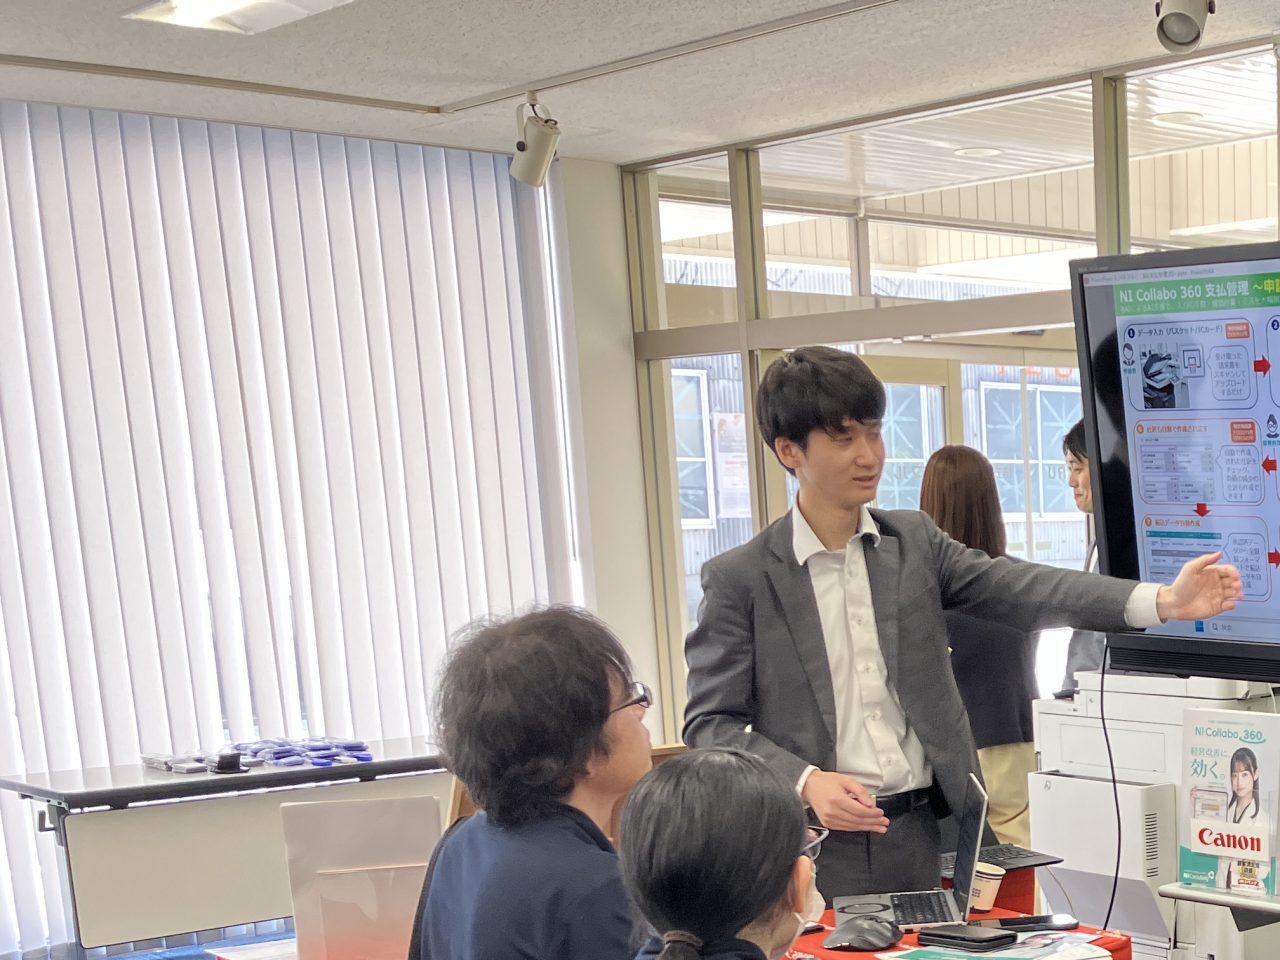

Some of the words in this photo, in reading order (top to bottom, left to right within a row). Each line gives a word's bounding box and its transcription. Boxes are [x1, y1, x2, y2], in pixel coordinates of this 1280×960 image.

[1119, 290, 1133, 303] NI
[1136, 287, 1177, 302] Collabo
[1180, 286, 1202, 299] 360
[1205, 279, 1249, 297] 支払管理
[1195, 726, 1205, 736] NI
[1205, 727, 1239, 739] Collabo
[1243, 729, 1263, 741] 360
[1191, 758, 1226, 780] 効く。
[1198, 827, 1262, 852] Canon
